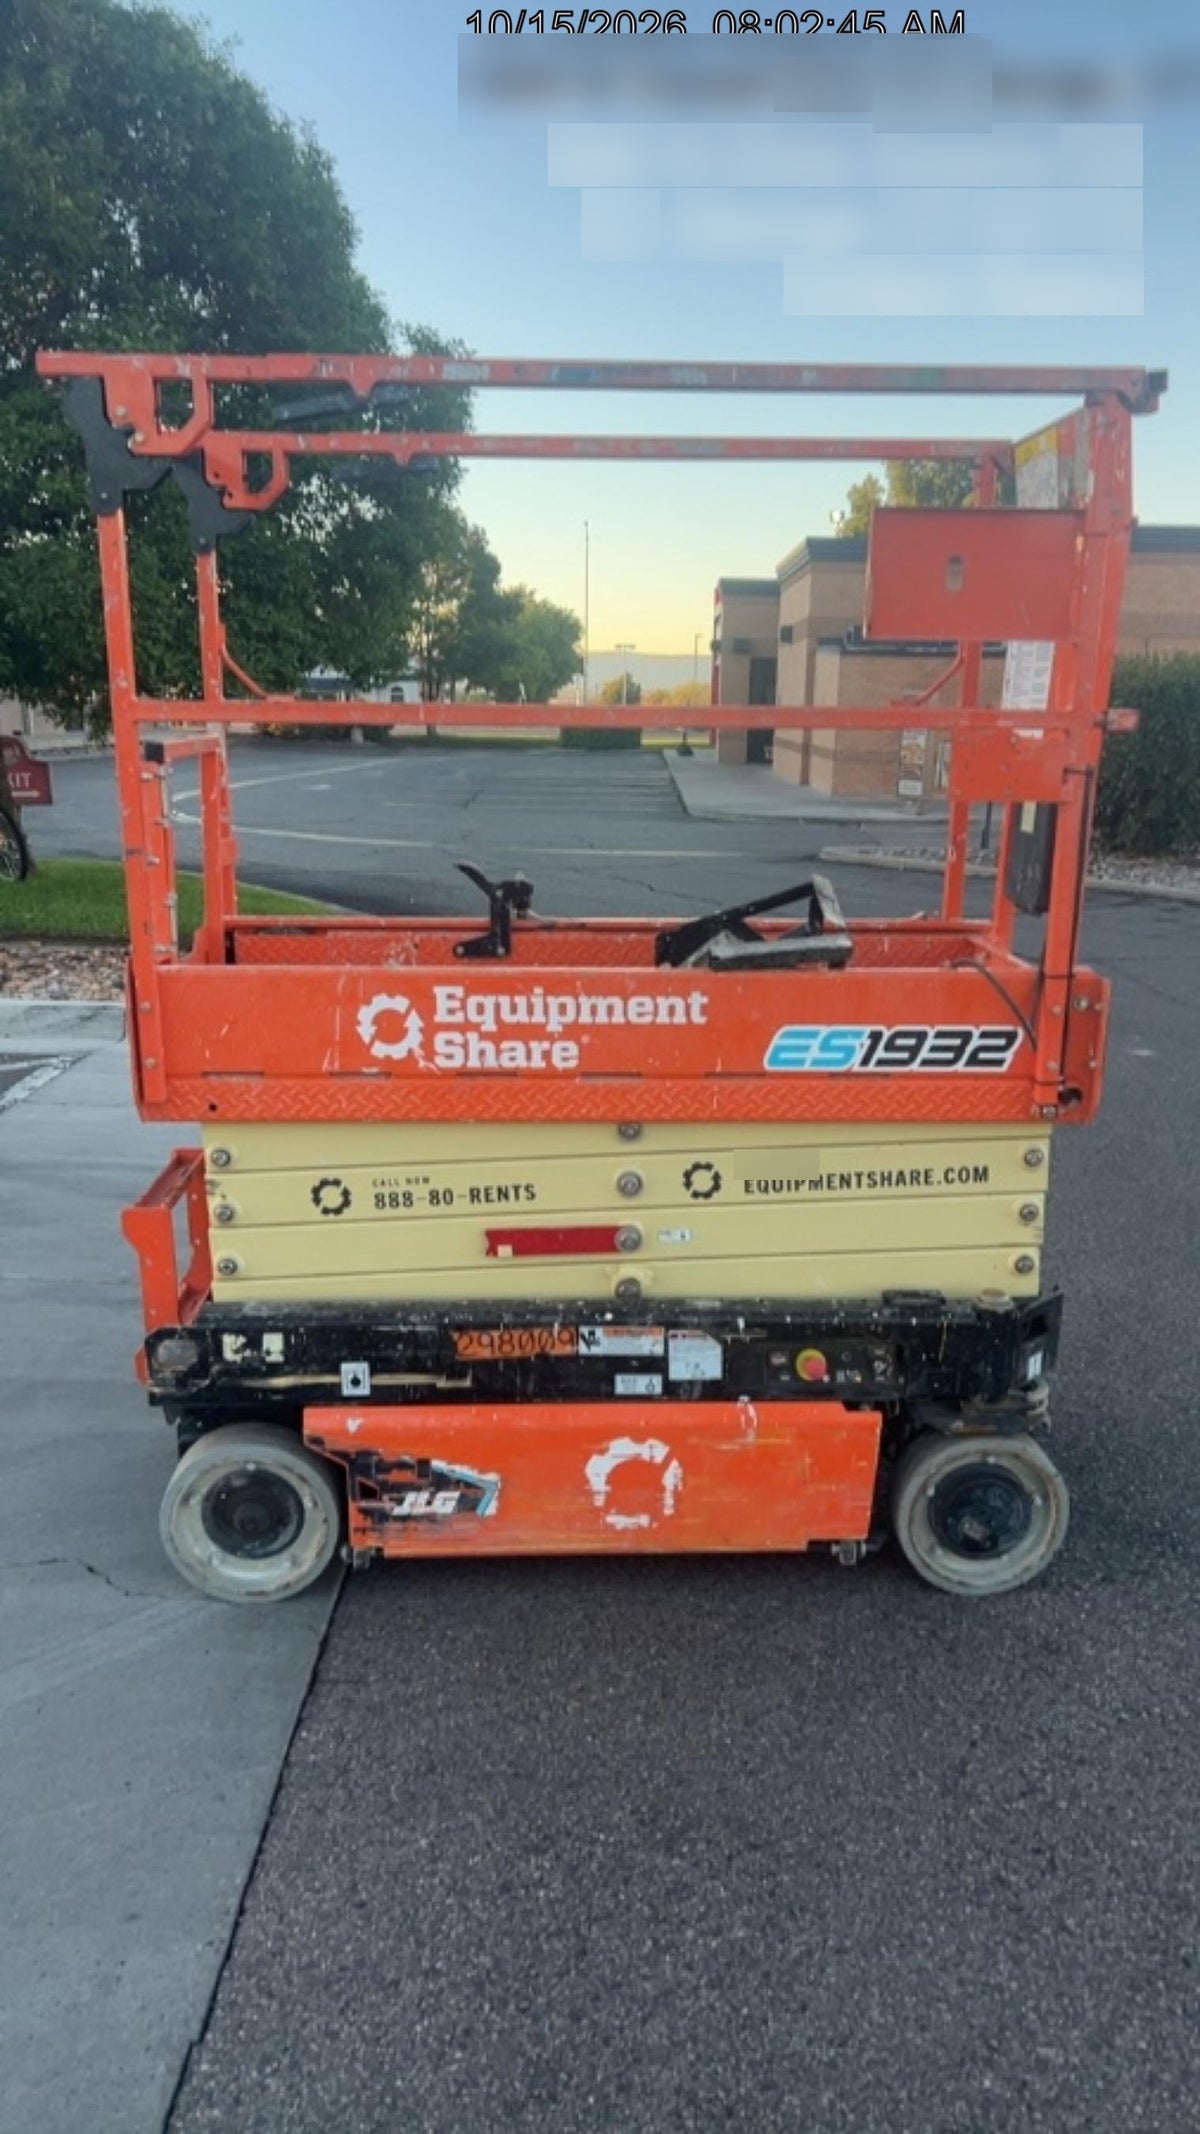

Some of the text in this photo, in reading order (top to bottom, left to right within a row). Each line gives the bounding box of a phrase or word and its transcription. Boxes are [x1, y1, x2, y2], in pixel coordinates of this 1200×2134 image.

[433, 985, 709, 1032] Equipment
[433, 1032, 579, 1068] Share
[764, 1025, 1023, 1072] ES1932
[372, 1175, 430, 1188] CALL NOW
[743, 1165, 989, 1195] EQUIPMENTSHARE.COM
[374, 1183, 537, 1211] 888-80-RENTS
[393, 1491, 461, 1516] JLG
